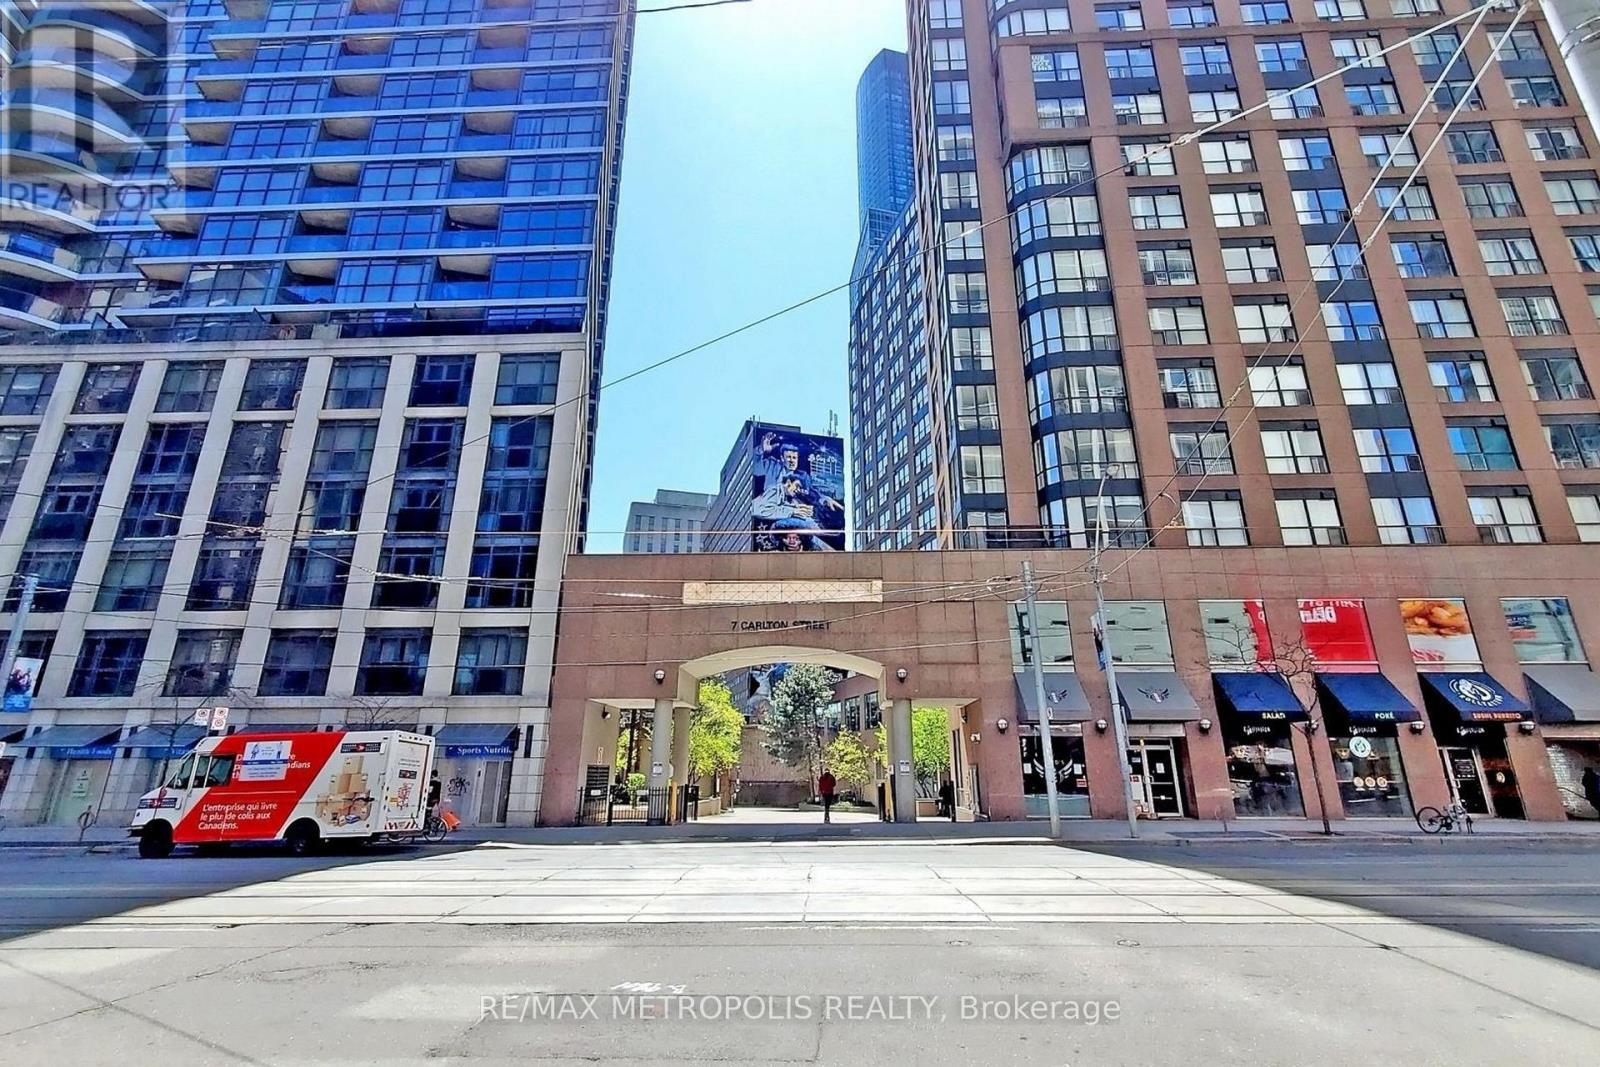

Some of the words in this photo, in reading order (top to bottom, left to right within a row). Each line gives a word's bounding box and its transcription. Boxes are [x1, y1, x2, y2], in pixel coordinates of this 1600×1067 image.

[731, 621, 737, 631] 7
[741, 621, 788, 631] CARLTON
[792, 620, 832, 631] STREET
[457, 746, 481, 755] Sports
[484, 746, 512, 754] Nutriti
[247, 802, 260, 814] qui
[238, 811, 256, 820] colis
[256, 812, 271, 820] aux
